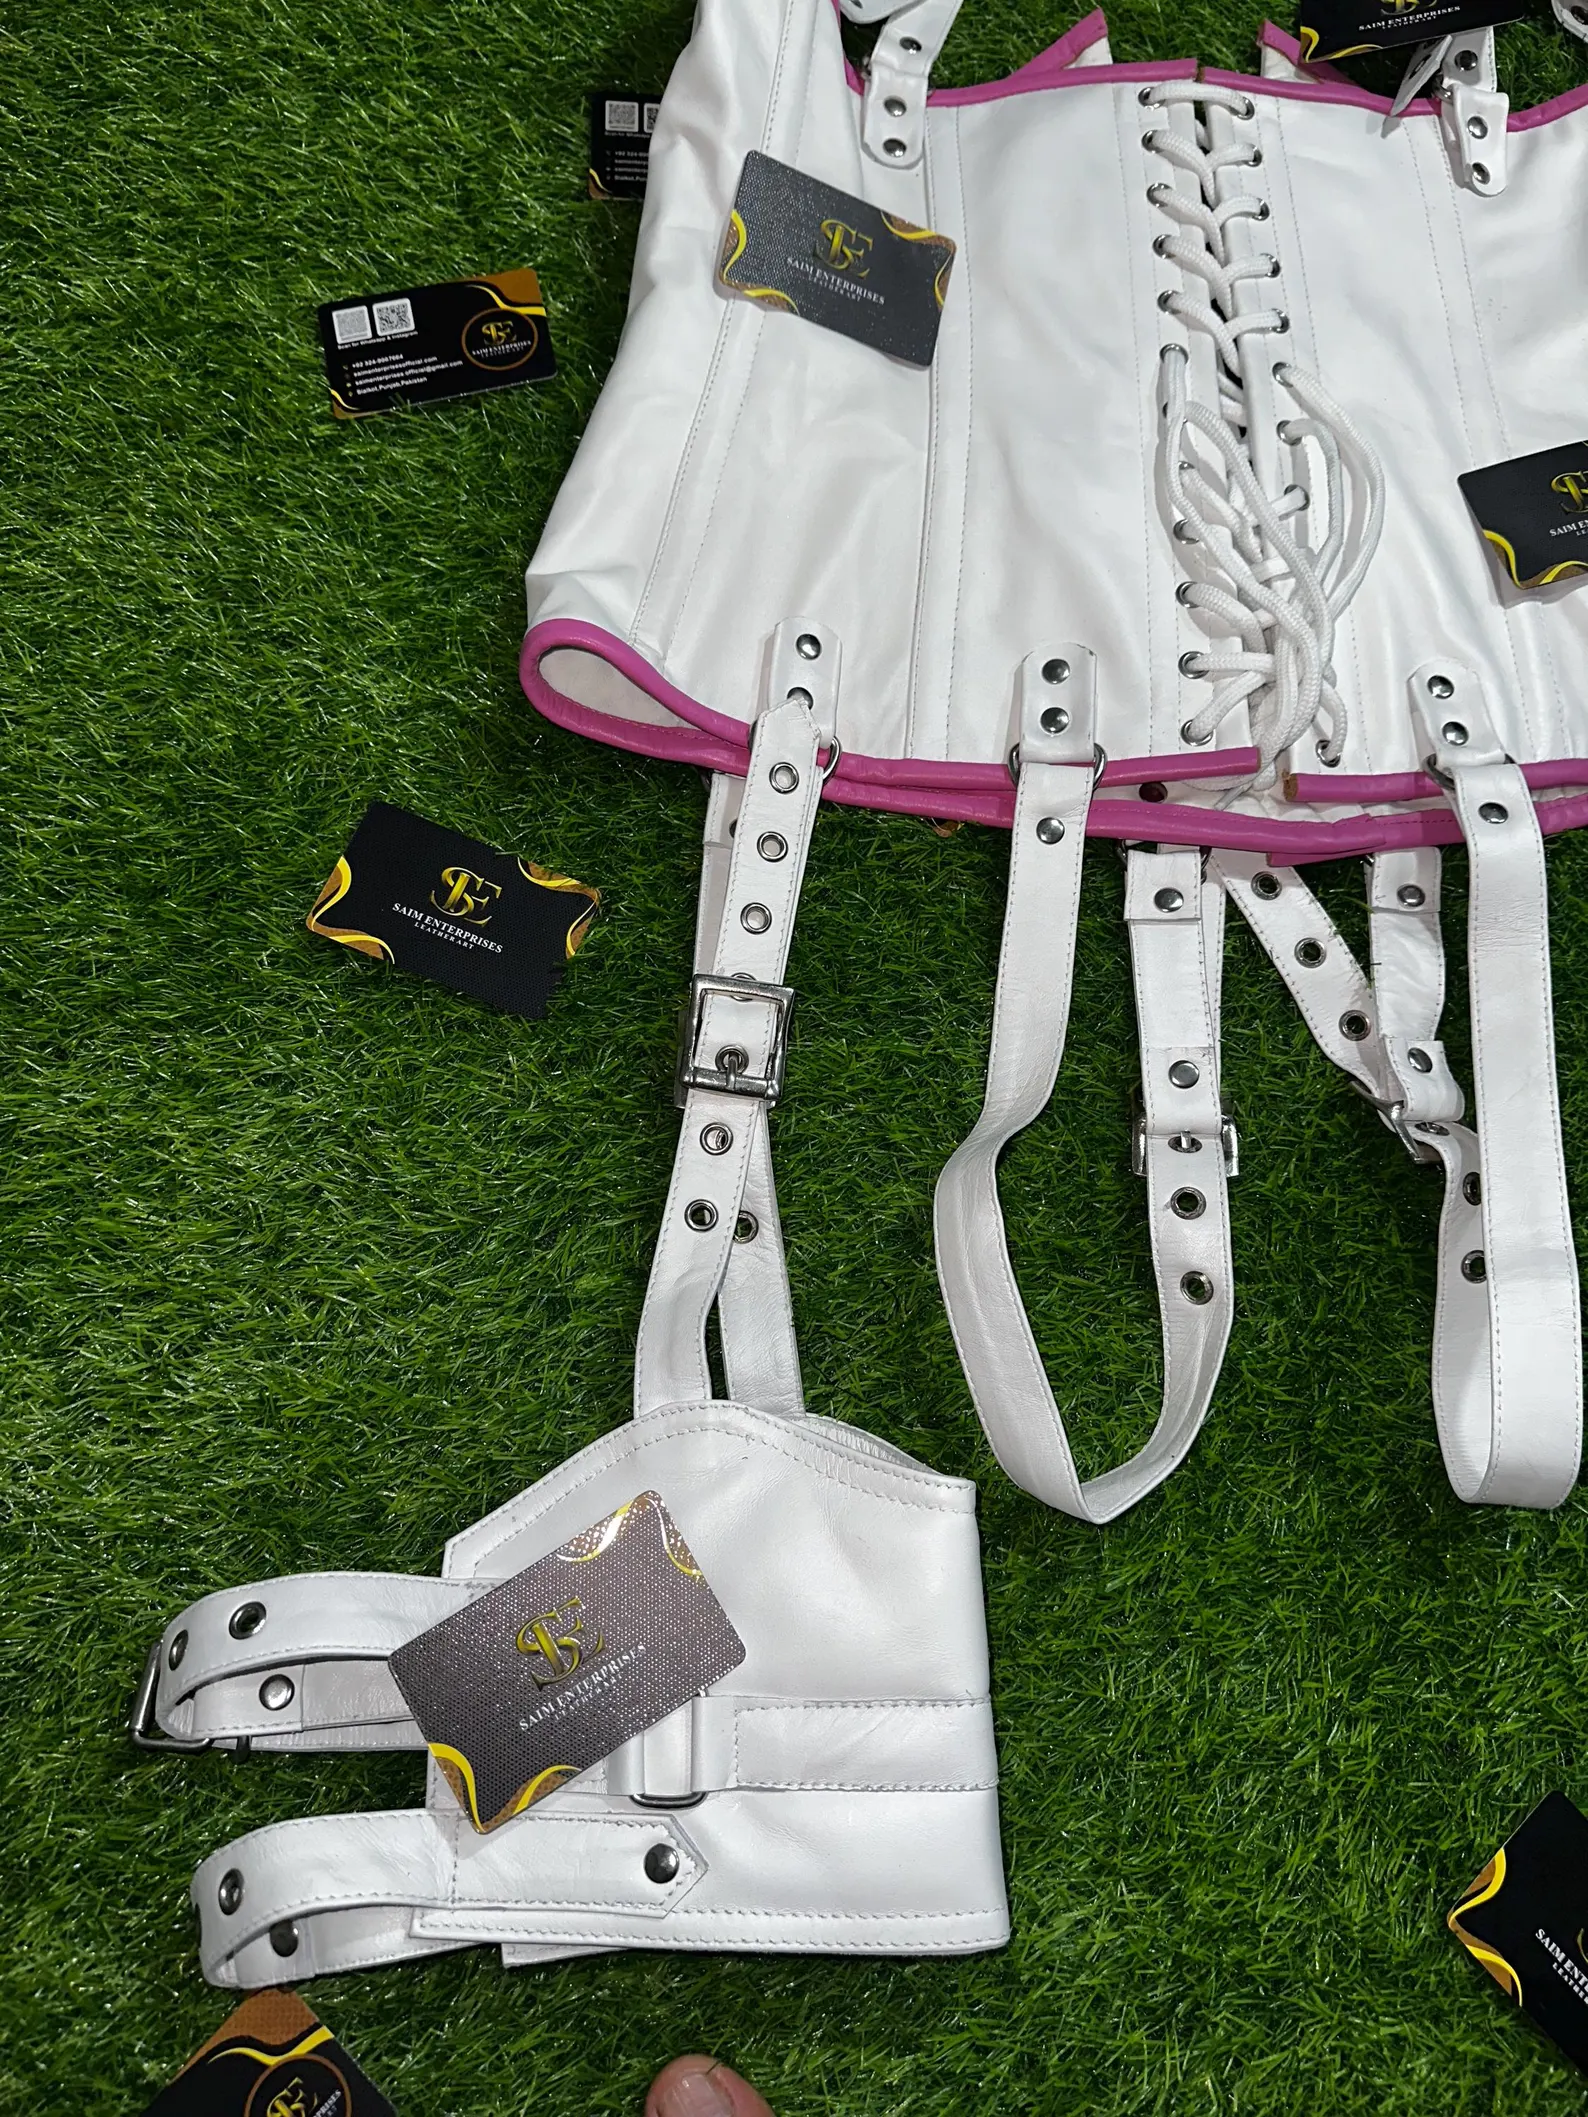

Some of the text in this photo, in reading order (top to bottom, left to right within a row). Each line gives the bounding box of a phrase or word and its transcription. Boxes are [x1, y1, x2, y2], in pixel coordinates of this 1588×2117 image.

[1358, 21, 1385, 31] SAIM
[1388, 6, 1460, 25] ENTERPRISES
[787, 257, 885, 305] SAIM ENTERPRISES
[1549, 523, 1577, 537] SAIM
[392, 902, 503, 954] SAIM ENTERPRISES
[518, 1643, 647, 1732] SAIM ENTERPRISES
[1535, 1928, 1566, 1963] SAIM
[313, 2089, 342, 2117] PRISES
